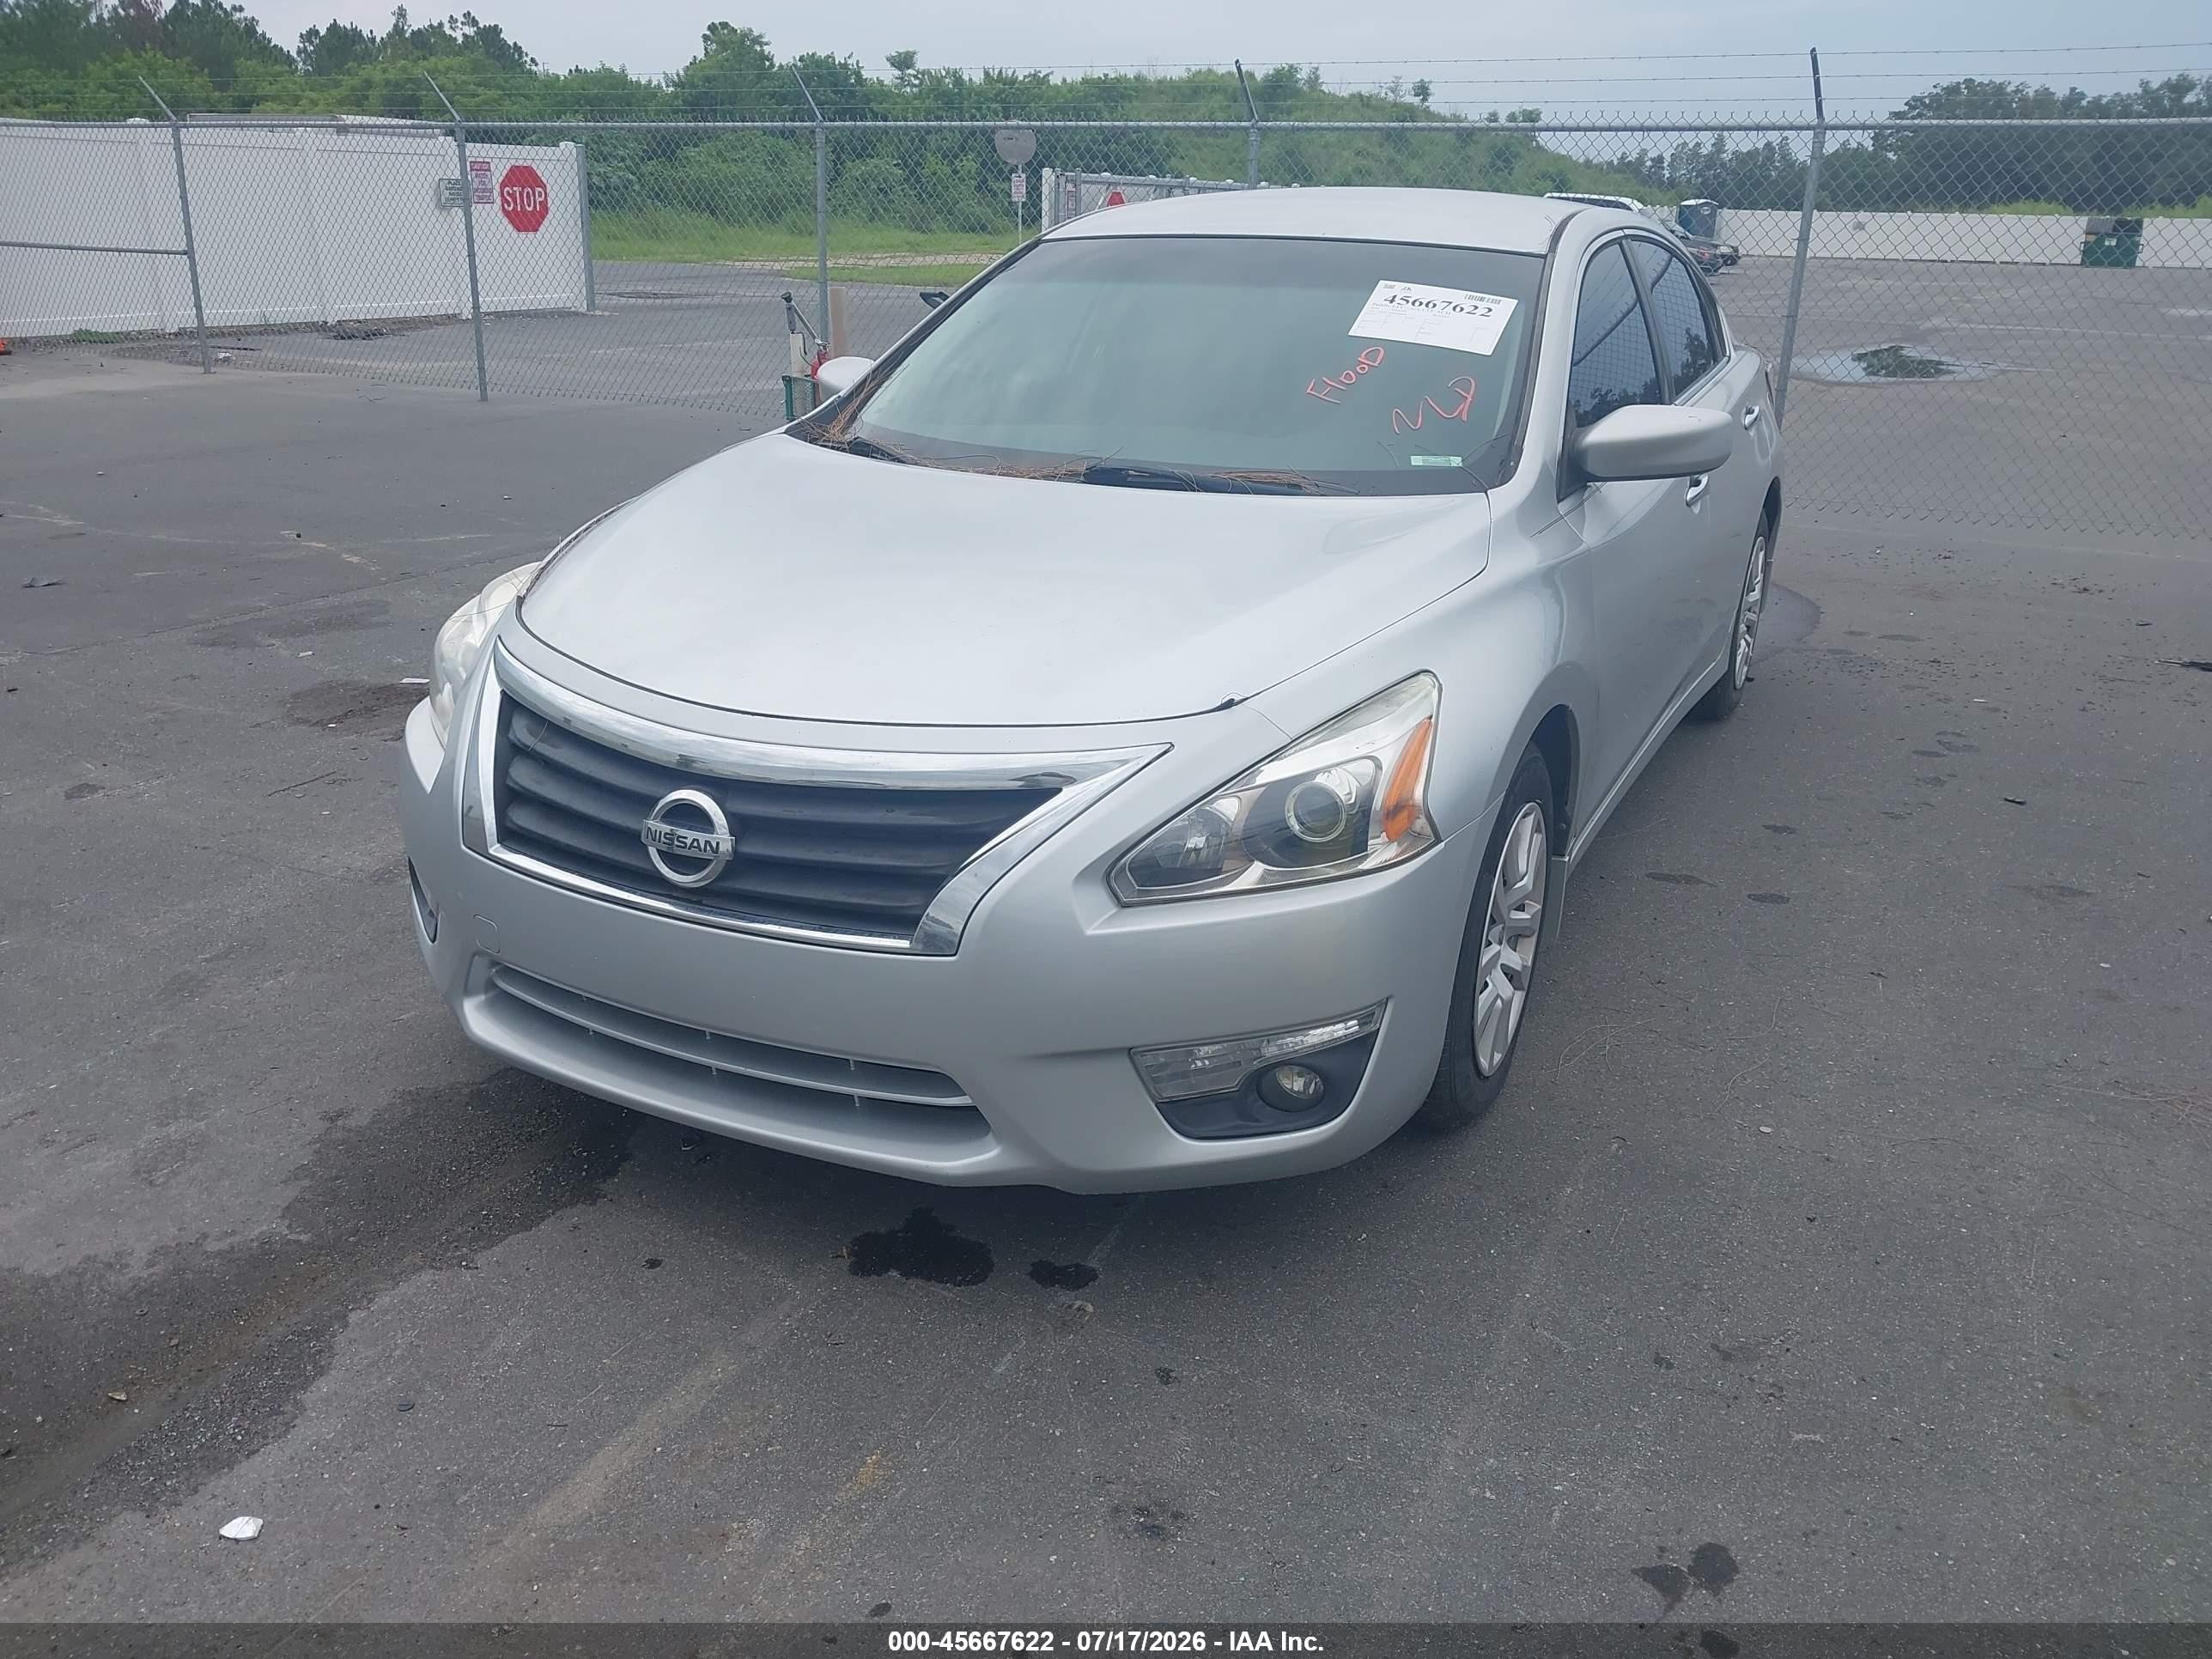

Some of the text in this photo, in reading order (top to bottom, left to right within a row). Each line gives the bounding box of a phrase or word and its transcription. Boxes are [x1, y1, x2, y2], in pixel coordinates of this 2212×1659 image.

[503, 186, 545, 212] STOP
[1383, 293, 1493, 318] 45667622
[646, 826, 720, 855] NISSAN
